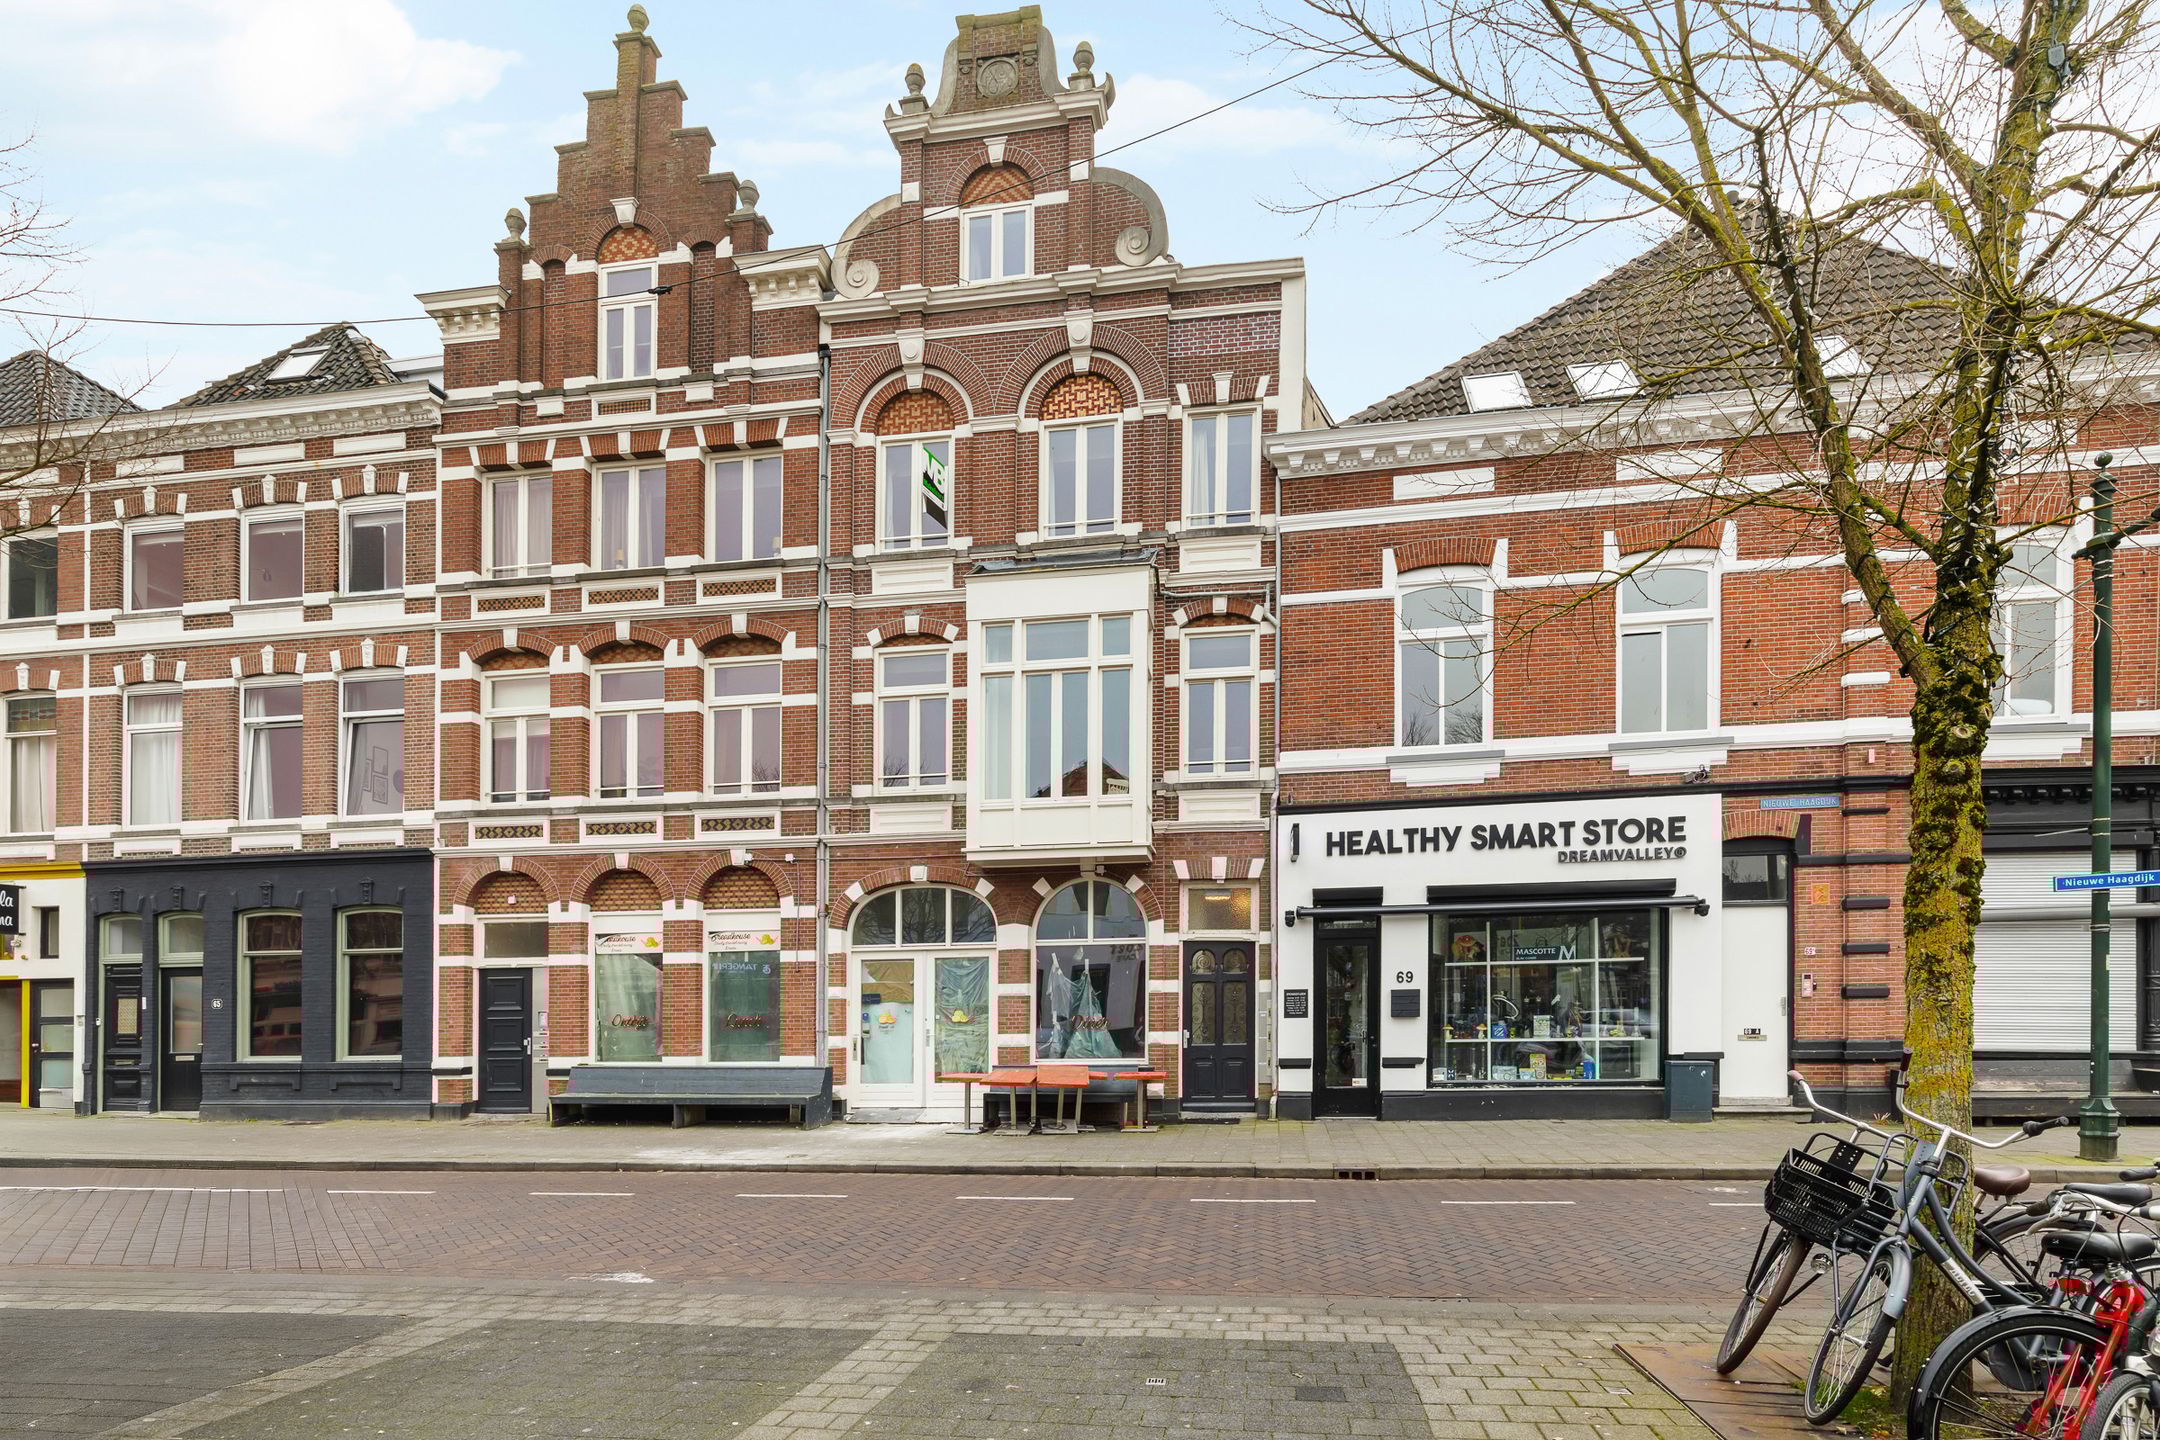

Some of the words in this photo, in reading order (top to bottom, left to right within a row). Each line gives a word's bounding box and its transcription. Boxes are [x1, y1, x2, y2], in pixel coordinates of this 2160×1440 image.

[1763, 799, 1793, 808] NIEUWE
[1326, 825, 1463, 857] HEALTHY
[1470, 820, 1576, 851] SMART
[1582, 815, 1687, 846] STORE
[1557, 847, 1675, 863] DREAMVALLEY
[2065, 878, 2104, 887] Nieuwe
[2107, 873, 2155, 884] Haagdijk
[1396, 970, 1414, 983] 69
